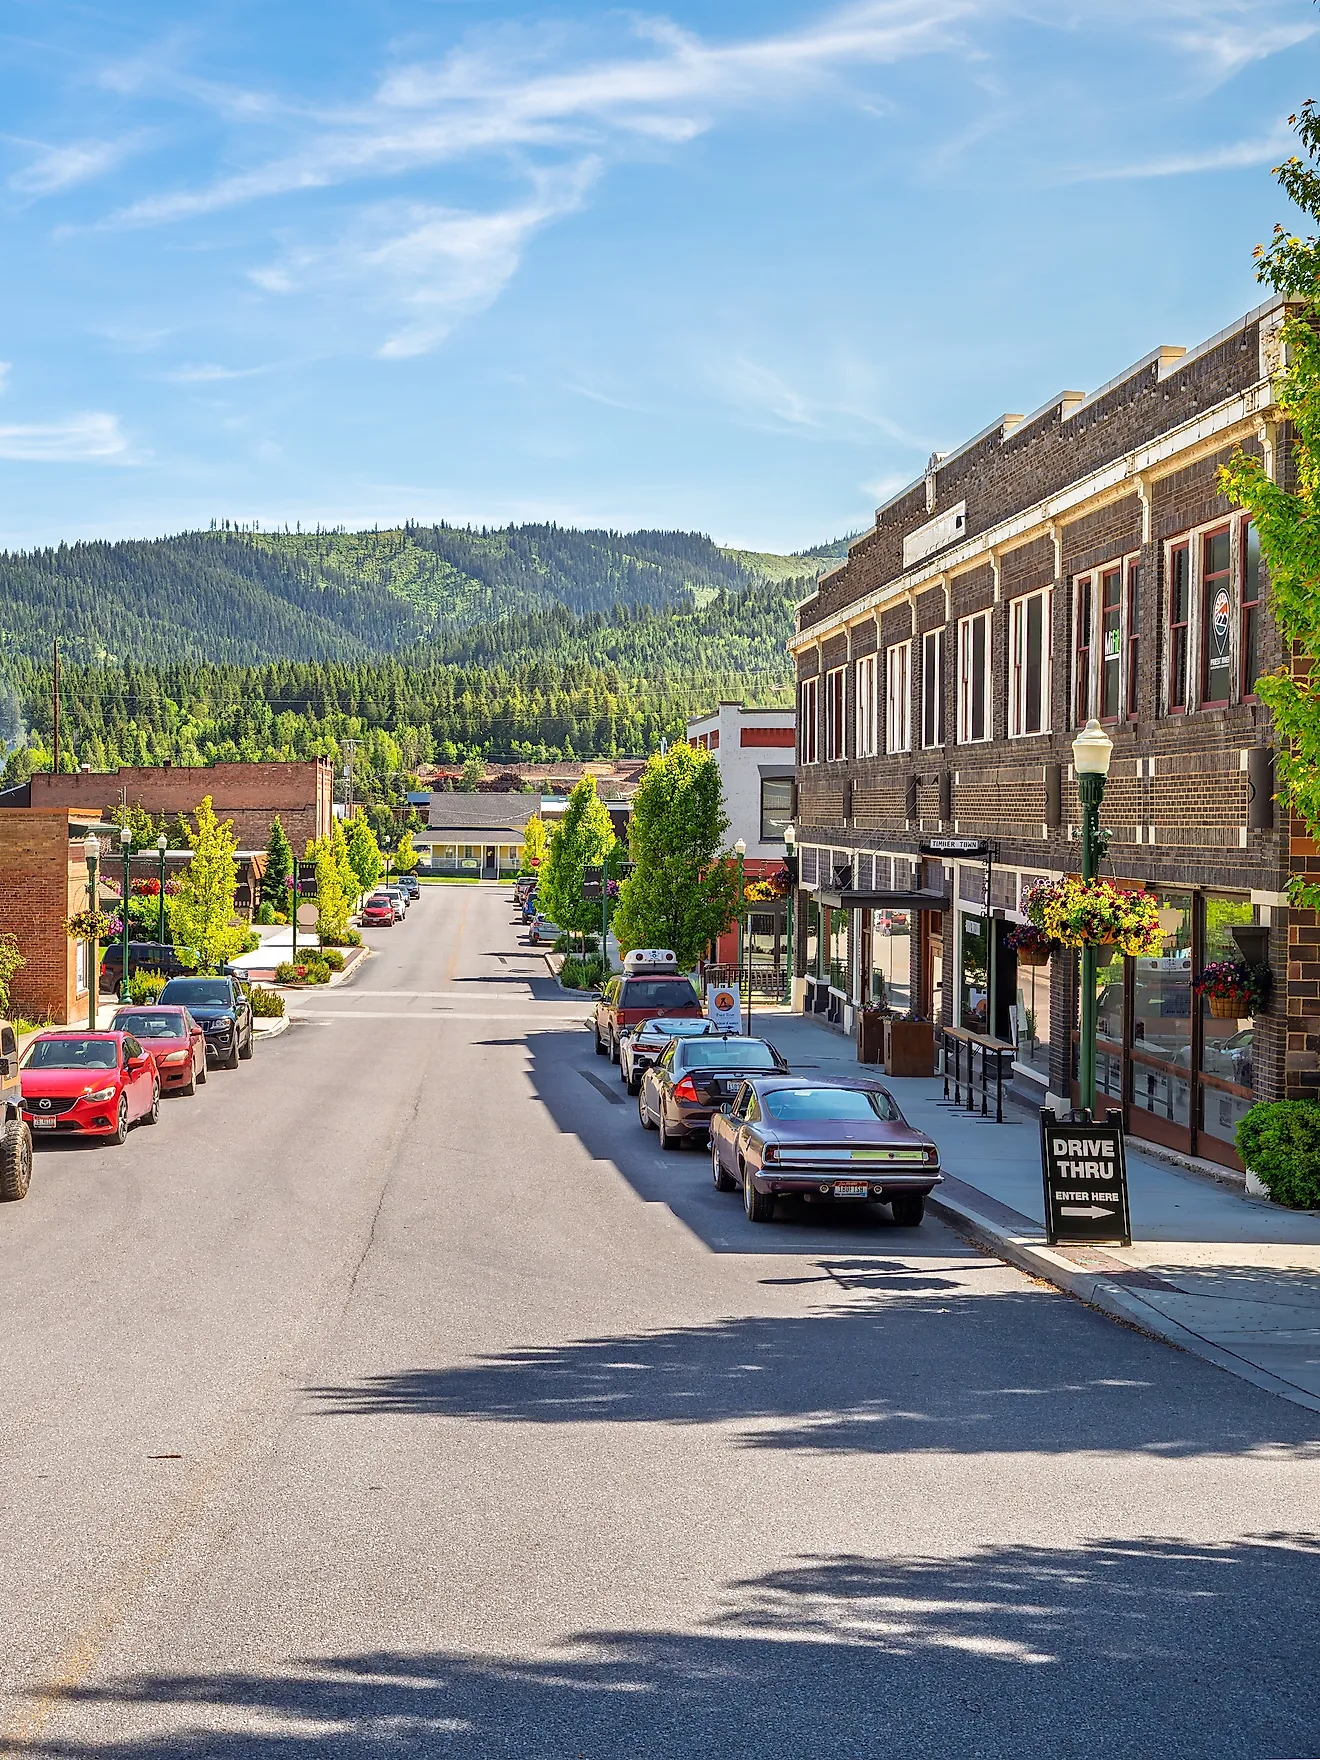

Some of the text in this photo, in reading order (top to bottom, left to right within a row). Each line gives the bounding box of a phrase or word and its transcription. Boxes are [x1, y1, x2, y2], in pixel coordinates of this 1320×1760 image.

[1053, 1139, 1115, 1157] DRIVE
[1056, 1161, 1114, 1179] THRU
[1055, 1191, 1120, 1202] ENTER HERE
